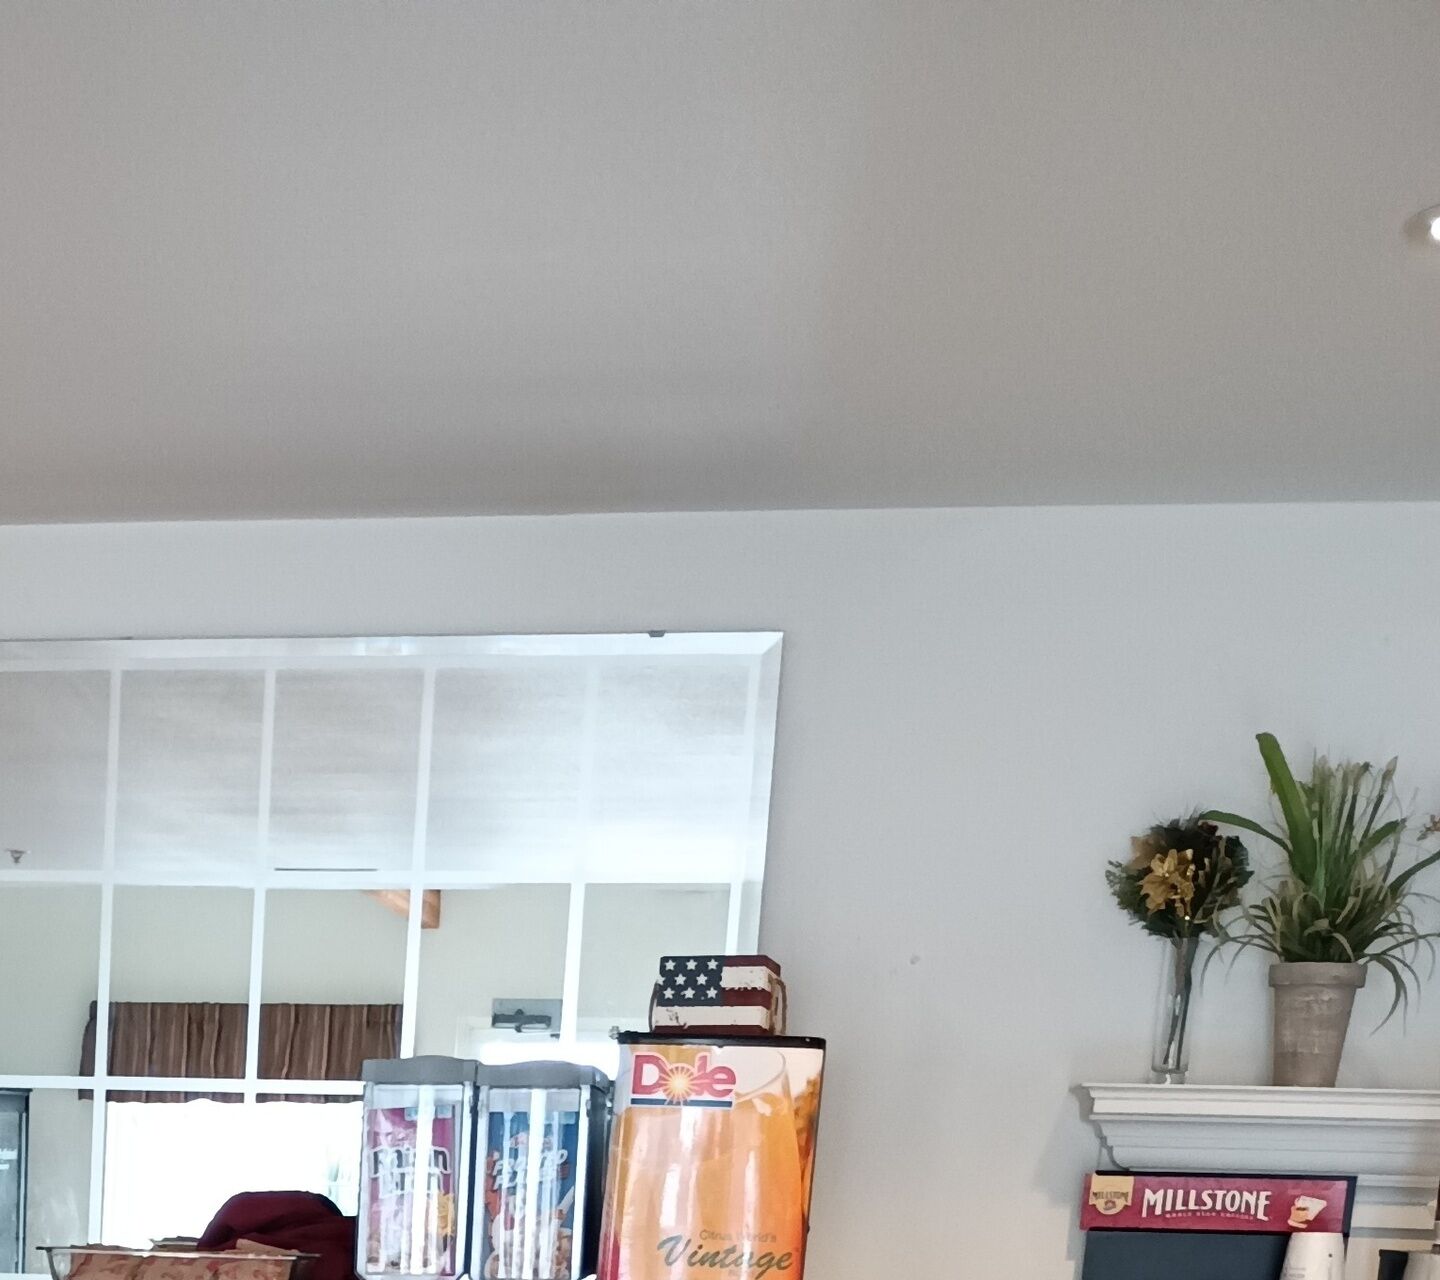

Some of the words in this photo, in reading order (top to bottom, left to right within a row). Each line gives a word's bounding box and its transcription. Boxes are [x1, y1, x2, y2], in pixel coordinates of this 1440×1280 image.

[631, 1053, 737, 1100] Dole
[1141, 1188, 1273, 1221] MILLSTONE
[657, 1234, 793, 1280] Vintage
